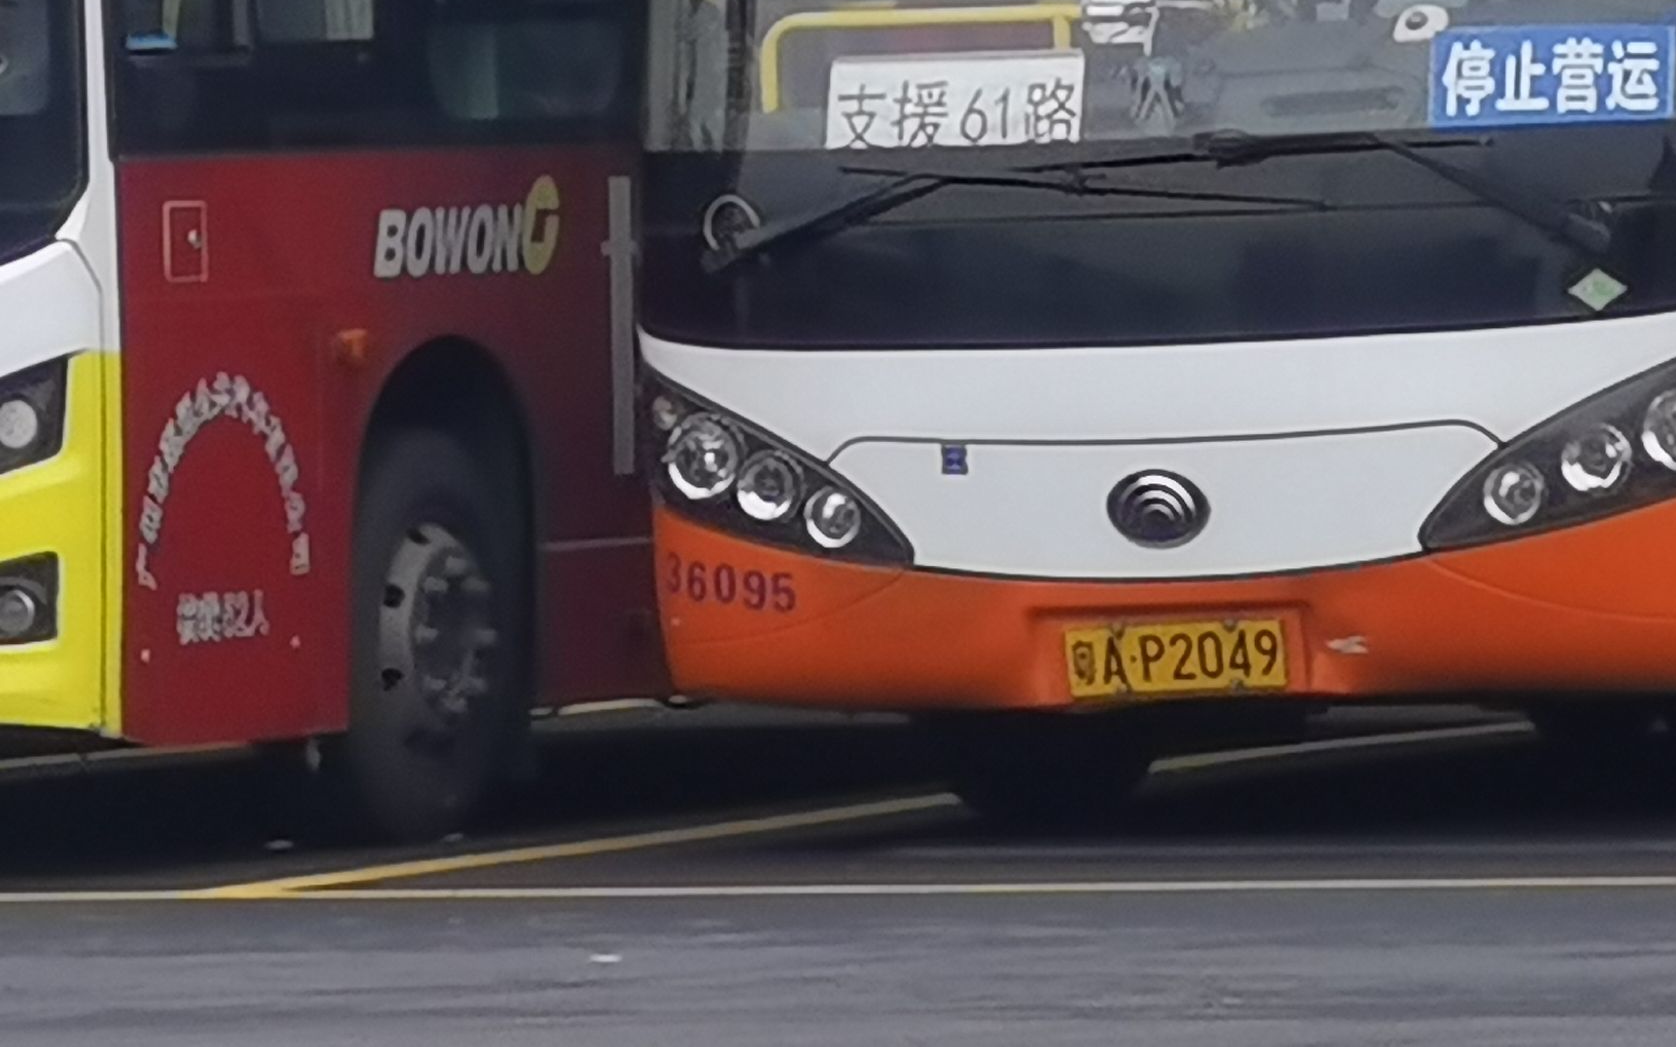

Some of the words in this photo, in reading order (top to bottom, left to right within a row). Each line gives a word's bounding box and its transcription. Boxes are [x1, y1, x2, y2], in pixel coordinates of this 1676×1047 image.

[836, 76, 1078, 147] 支援61路
[1442, 37, 1661, 117] 停止营运
[373, 174, 560, 279] BOWONG
[666, 550, 797, 613] 36095
